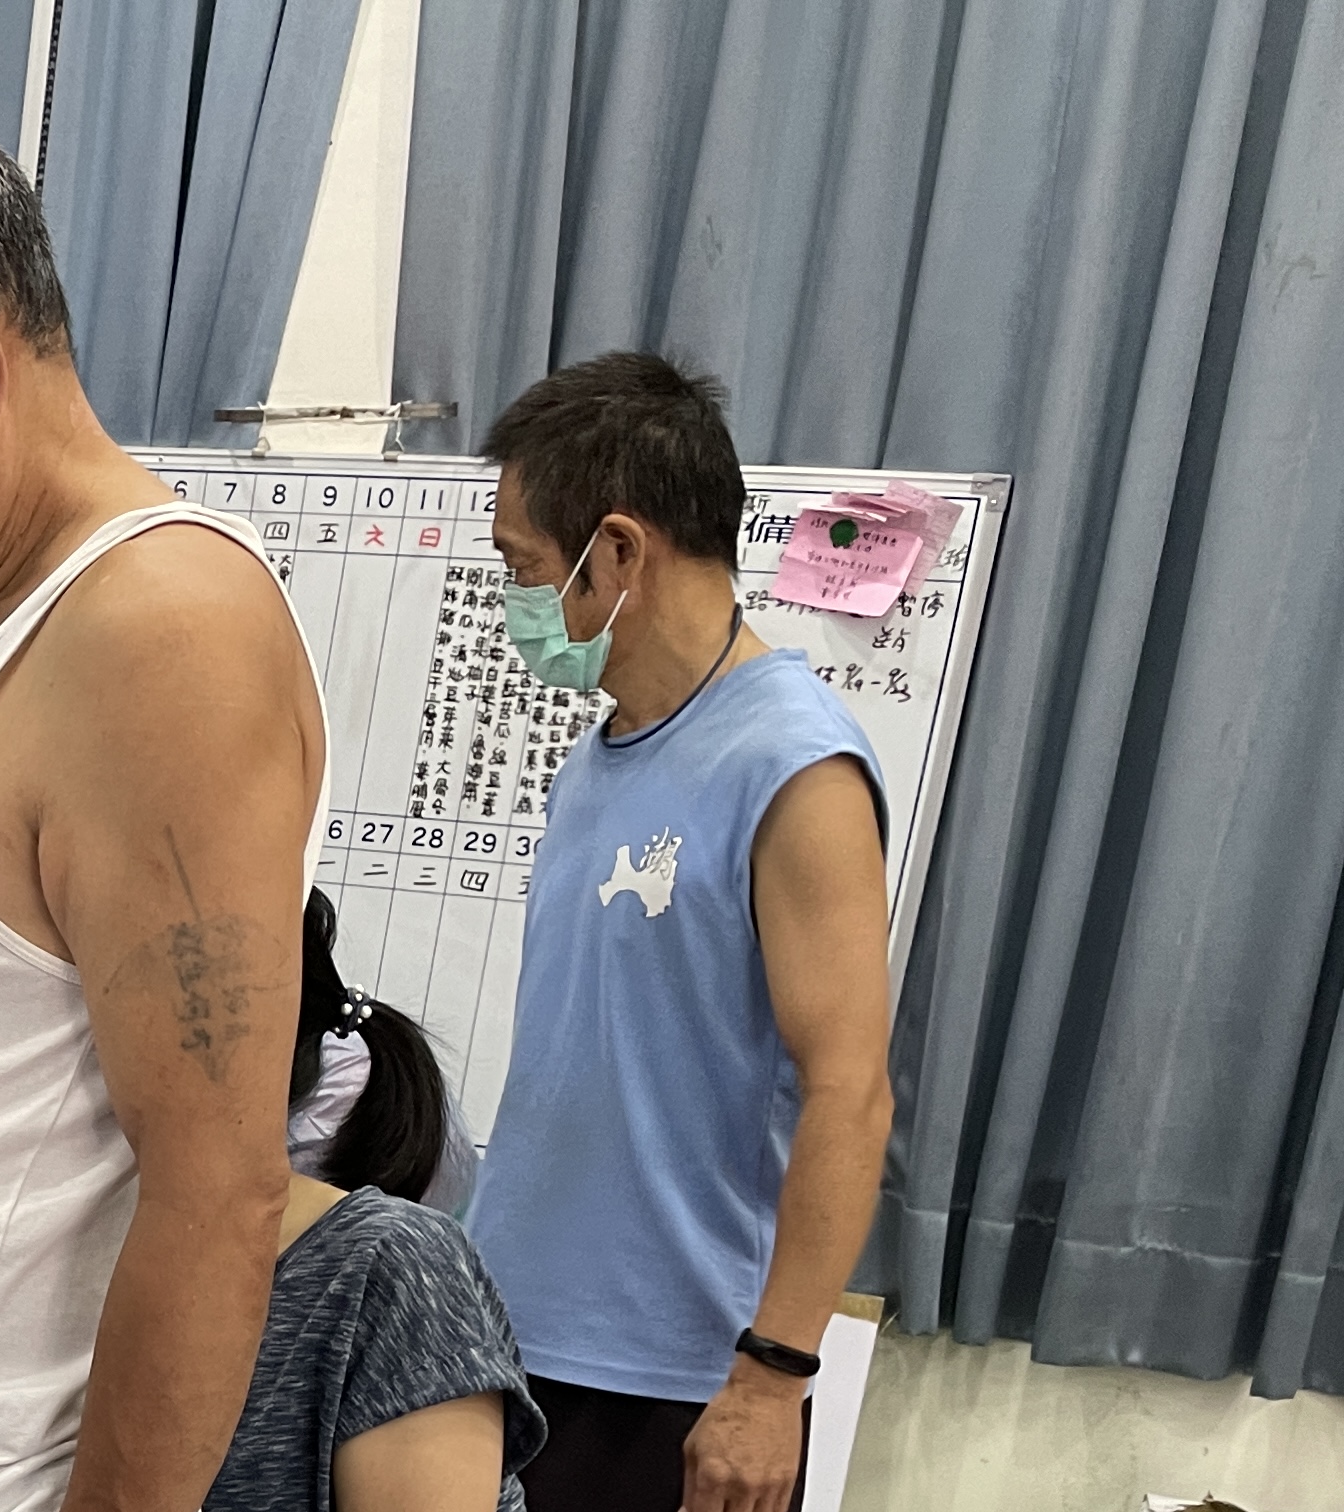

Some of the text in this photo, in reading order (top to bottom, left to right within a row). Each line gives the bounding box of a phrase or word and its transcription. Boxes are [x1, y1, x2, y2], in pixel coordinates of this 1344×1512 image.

[224, 482, 237, 502] 7
[272, 483, 287, 505] 8
[322, 485, 337, 507] 9
[366, 486, 394, 509] 10
[420, 489, 444, 511] 11
[316, 523, 339, 543] 五
[419, 527, 441, 548] 日
[328, 819, 541, 856] 6 27 28 29 3
[363, 863, 389, 876] 二
[413, 867, 437, 886] 三
[460, 870, 489, 892] 四
